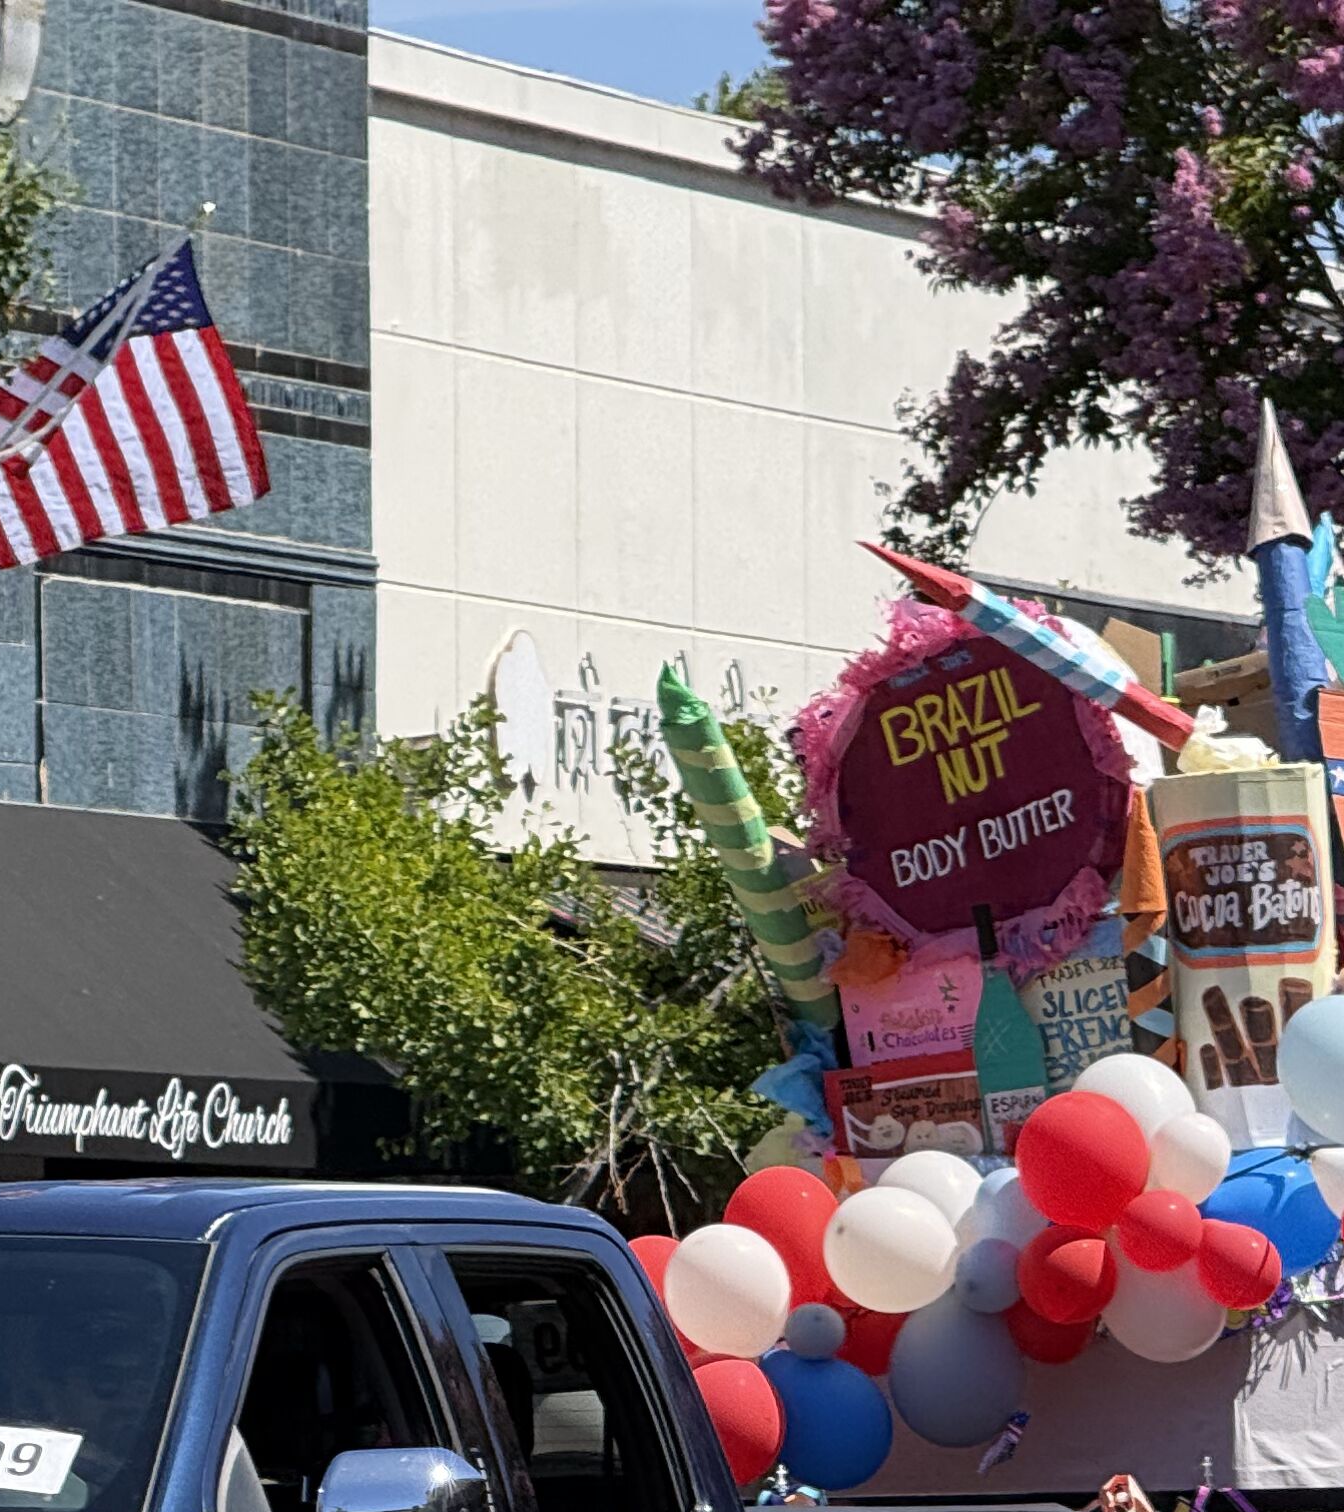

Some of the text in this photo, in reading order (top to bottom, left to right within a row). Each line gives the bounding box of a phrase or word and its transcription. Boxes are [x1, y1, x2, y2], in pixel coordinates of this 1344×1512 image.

[879, 667, 1042, 766] BRAZIL
[936, 728, 1009, 804] NUT
[890, 788, 1075, 887] BODY BUTTER
[1188, 841, 1269, 867] TRADER
[1205, 860, 1277, 886] JOE'S
[1039, 1014, 1132, 1054] FRENC
[149, 1077, 201, 1160] Life
[203, 1082, 292, 1149] Church
